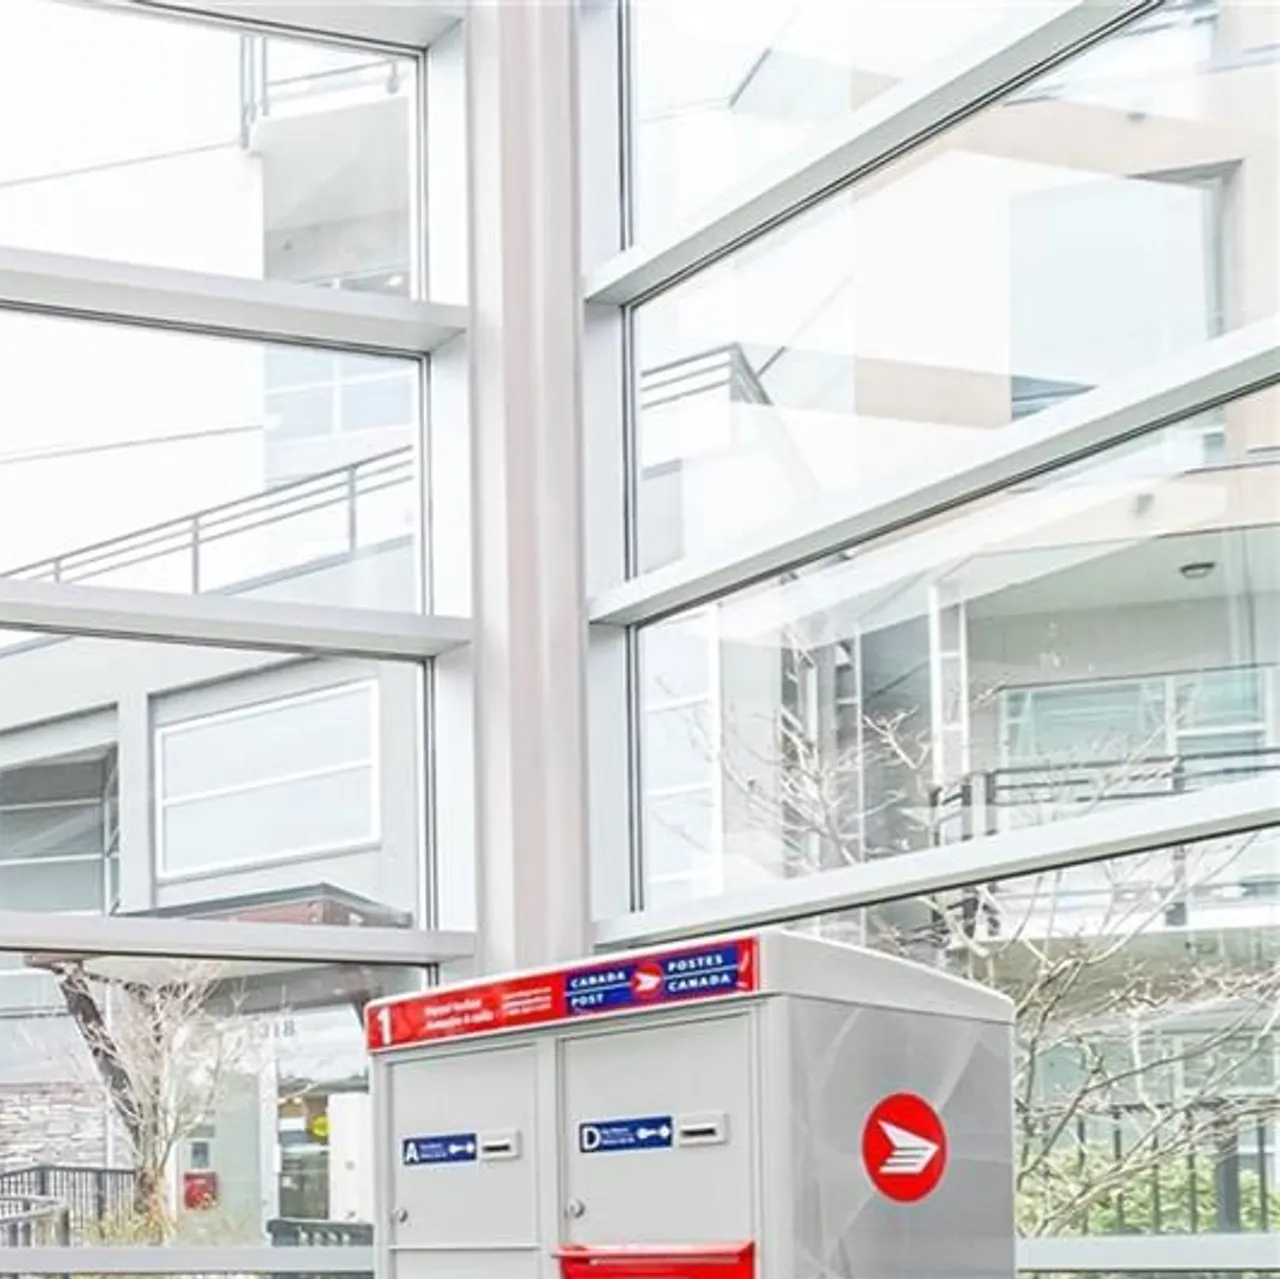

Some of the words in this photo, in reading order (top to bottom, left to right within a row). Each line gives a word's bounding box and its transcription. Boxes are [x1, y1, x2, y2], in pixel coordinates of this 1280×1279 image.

[667, 953, 724, 973] POSTES
[667, 973, 732, 993] CANADA
[571, 992, 605, 1008] POST
[376, 1006, 392, 1045] 1
[583, 1126, 601, 1150] D
[406, 1141, 420, 1162] A
